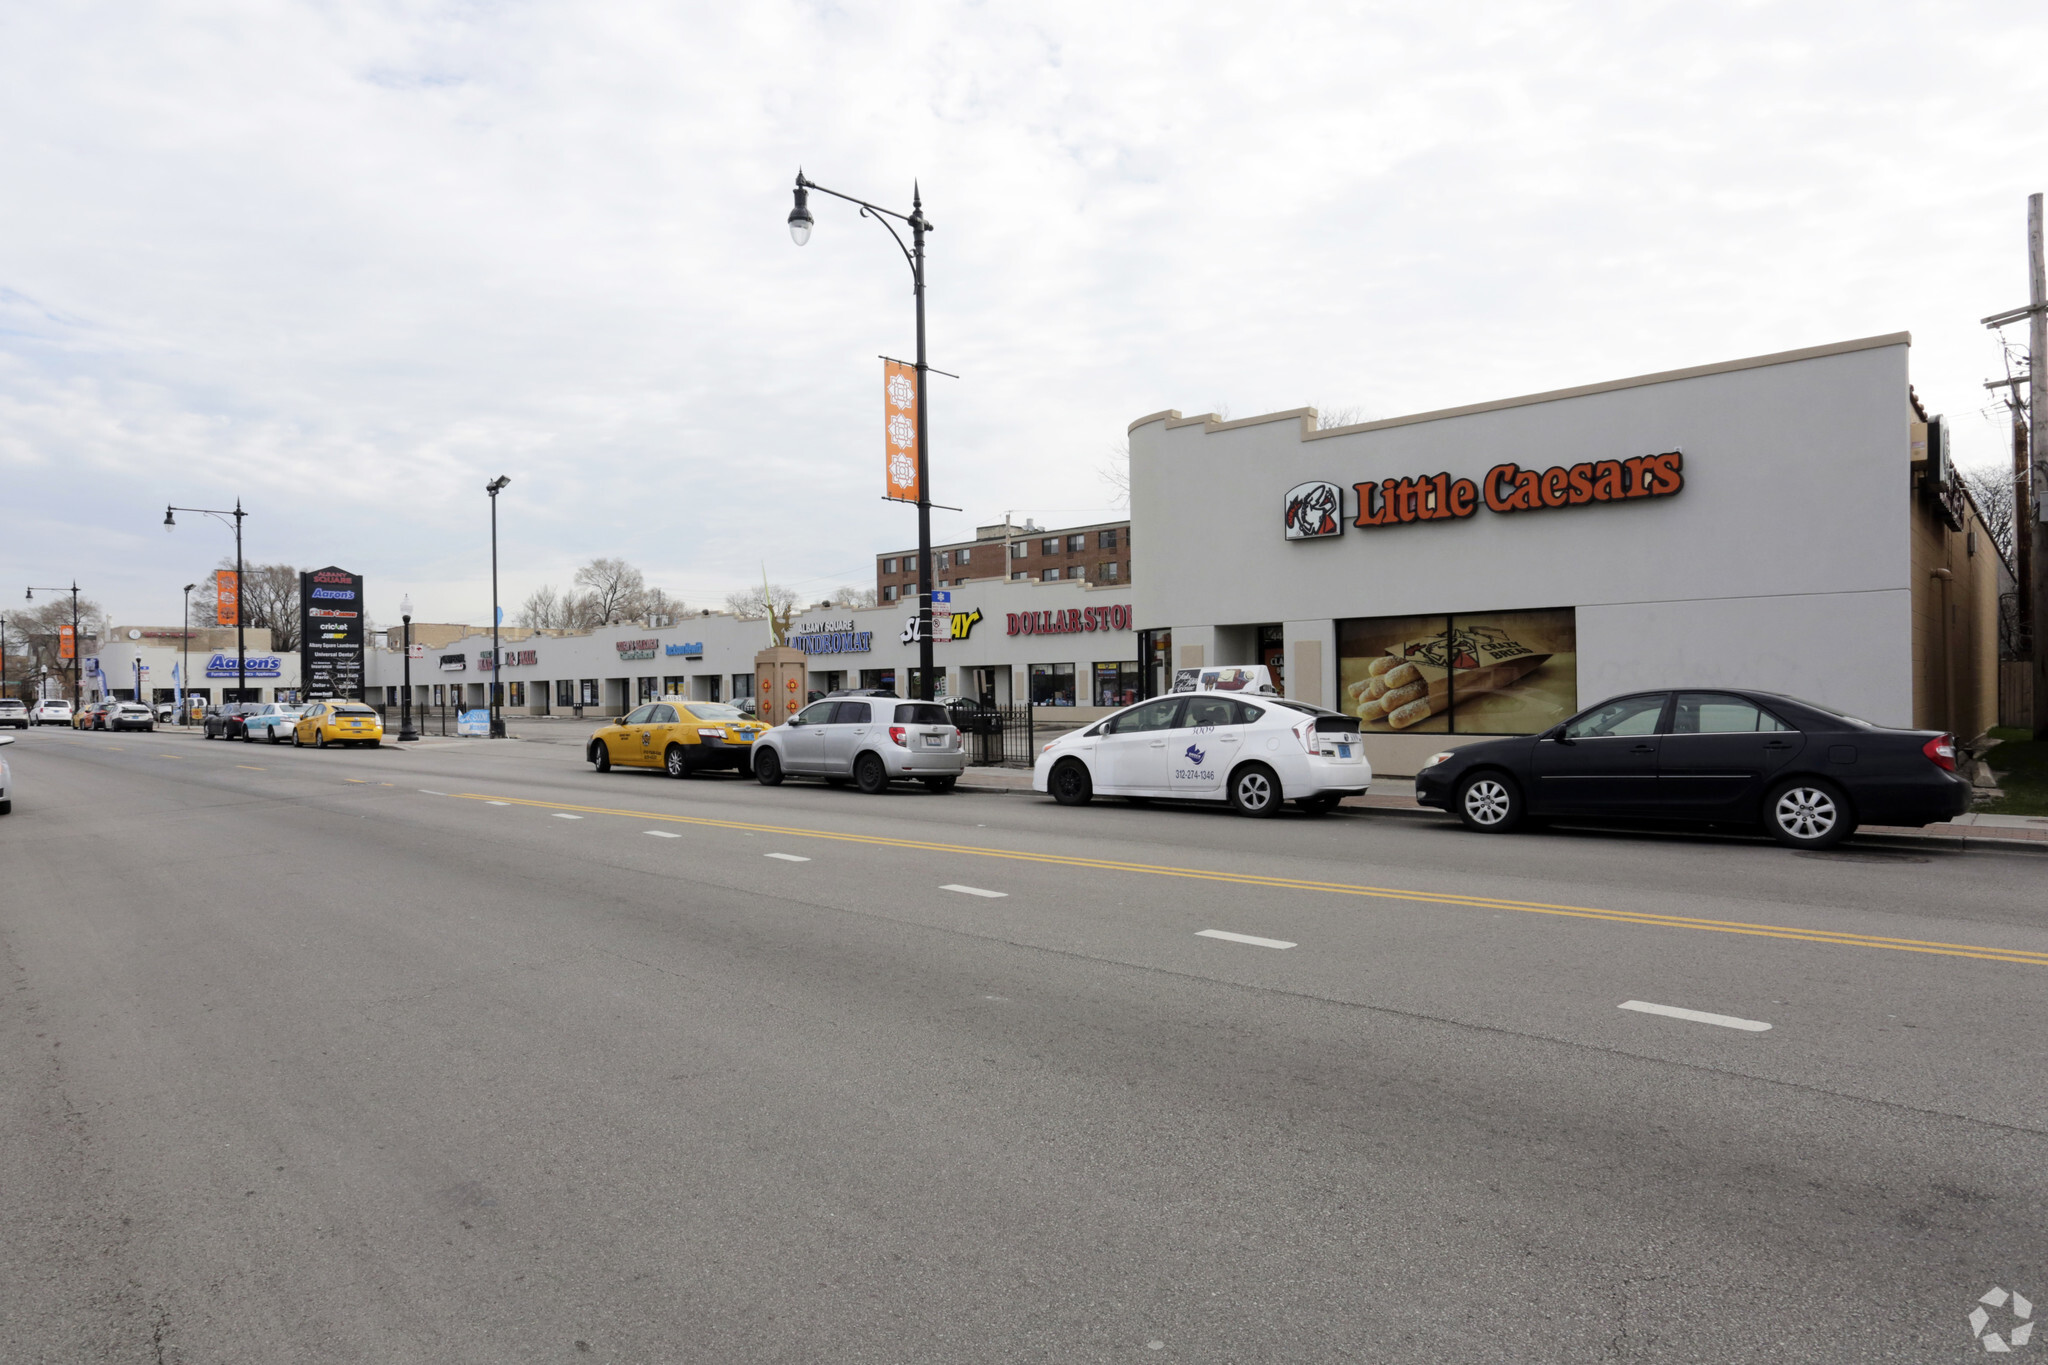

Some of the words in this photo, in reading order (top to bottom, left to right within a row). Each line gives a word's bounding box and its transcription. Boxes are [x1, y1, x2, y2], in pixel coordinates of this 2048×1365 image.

[1353, 472, 1478, 528] Little
[1484, 452, 1684, 513] Caesars
[313, 576, 352, 584] SQUARE
[311, 587, 355, 600] Aaron's
[320, 622, 348, 631] cricket
[800, 622, 824, 634] ALBANY
[824, 620, 854, 632] SQUARE
[900, 607, 983, 646] SUAY
[1006, 609, 1082, 635] DOLLAR
[1480, 641, 1522, 651] CRAZY
[1489, 648, 1533, 660] BREAD
[1176, 770, 1215, 780] 312-274-1346
